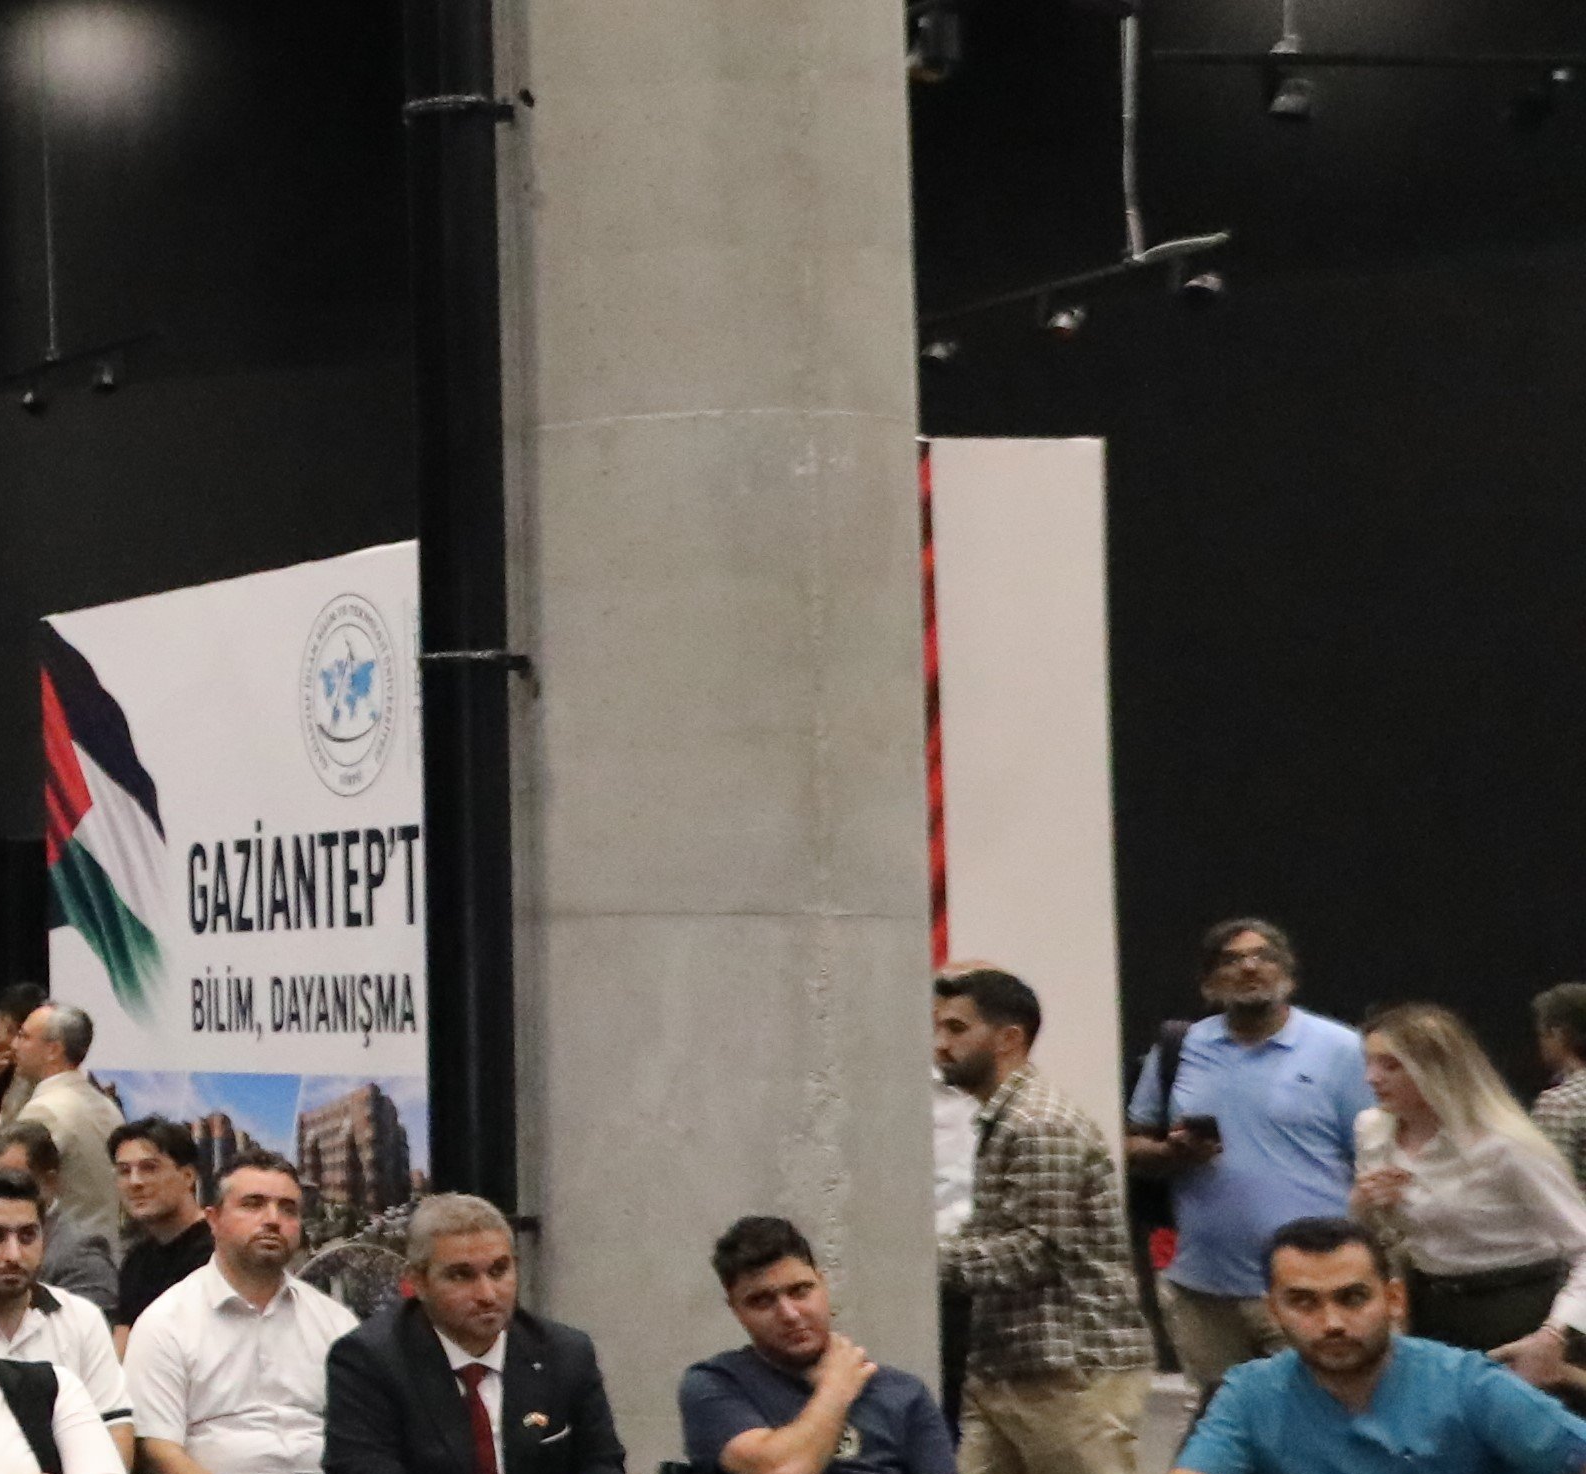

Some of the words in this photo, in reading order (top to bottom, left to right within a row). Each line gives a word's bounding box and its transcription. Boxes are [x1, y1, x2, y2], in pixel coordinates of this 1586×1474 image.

[188, 819, 420, 935] GAZİANTEP'T
[191, 965, 262, 1042] BİLİM,
[270, 973, 417, 1048] DAYANIŞMA
